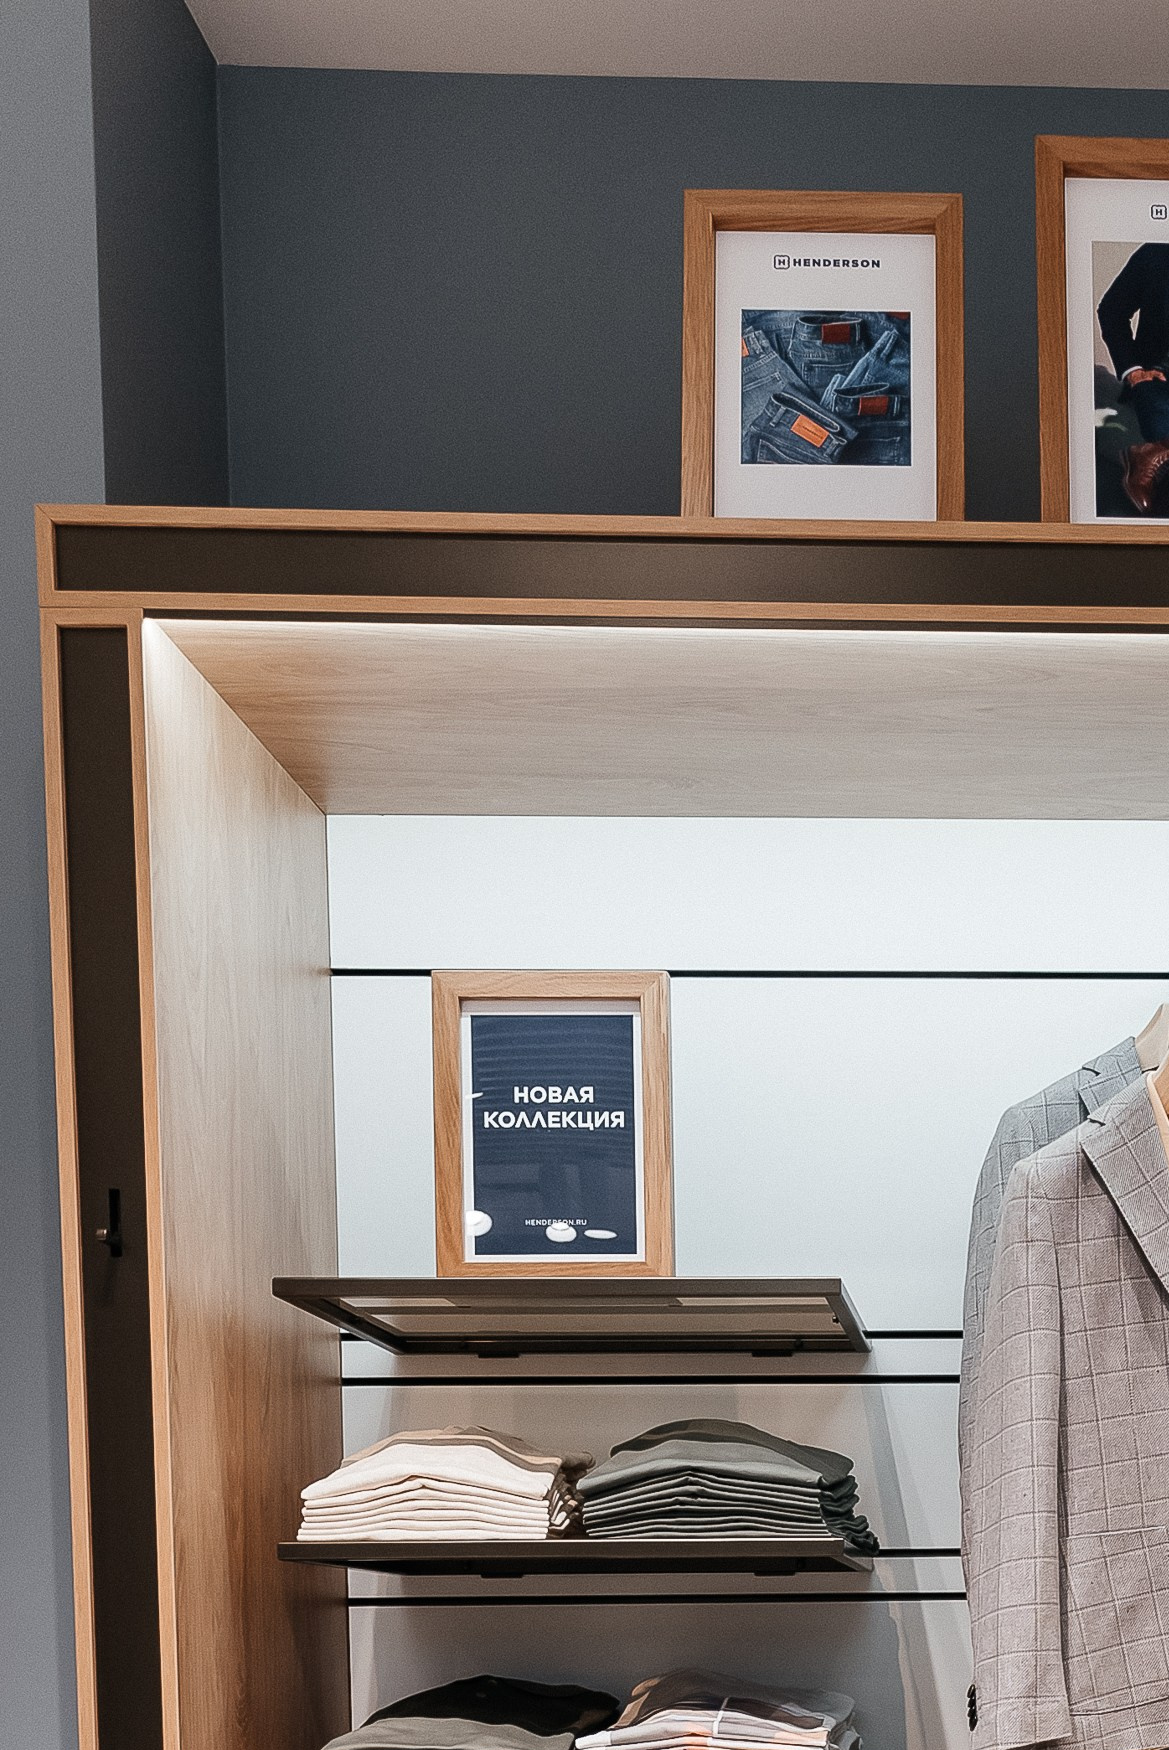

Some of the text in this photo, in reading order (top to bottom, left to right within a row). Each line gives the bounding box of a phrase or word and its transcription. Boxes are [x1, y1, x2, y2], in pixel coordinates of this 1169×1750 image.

[793, 258, 880, 268] HENDERSON
[513, 1086, 594, 1104] НОВАЯ
[483, 1110, 625, 1131] КОЛЛЕКЦИЯ
